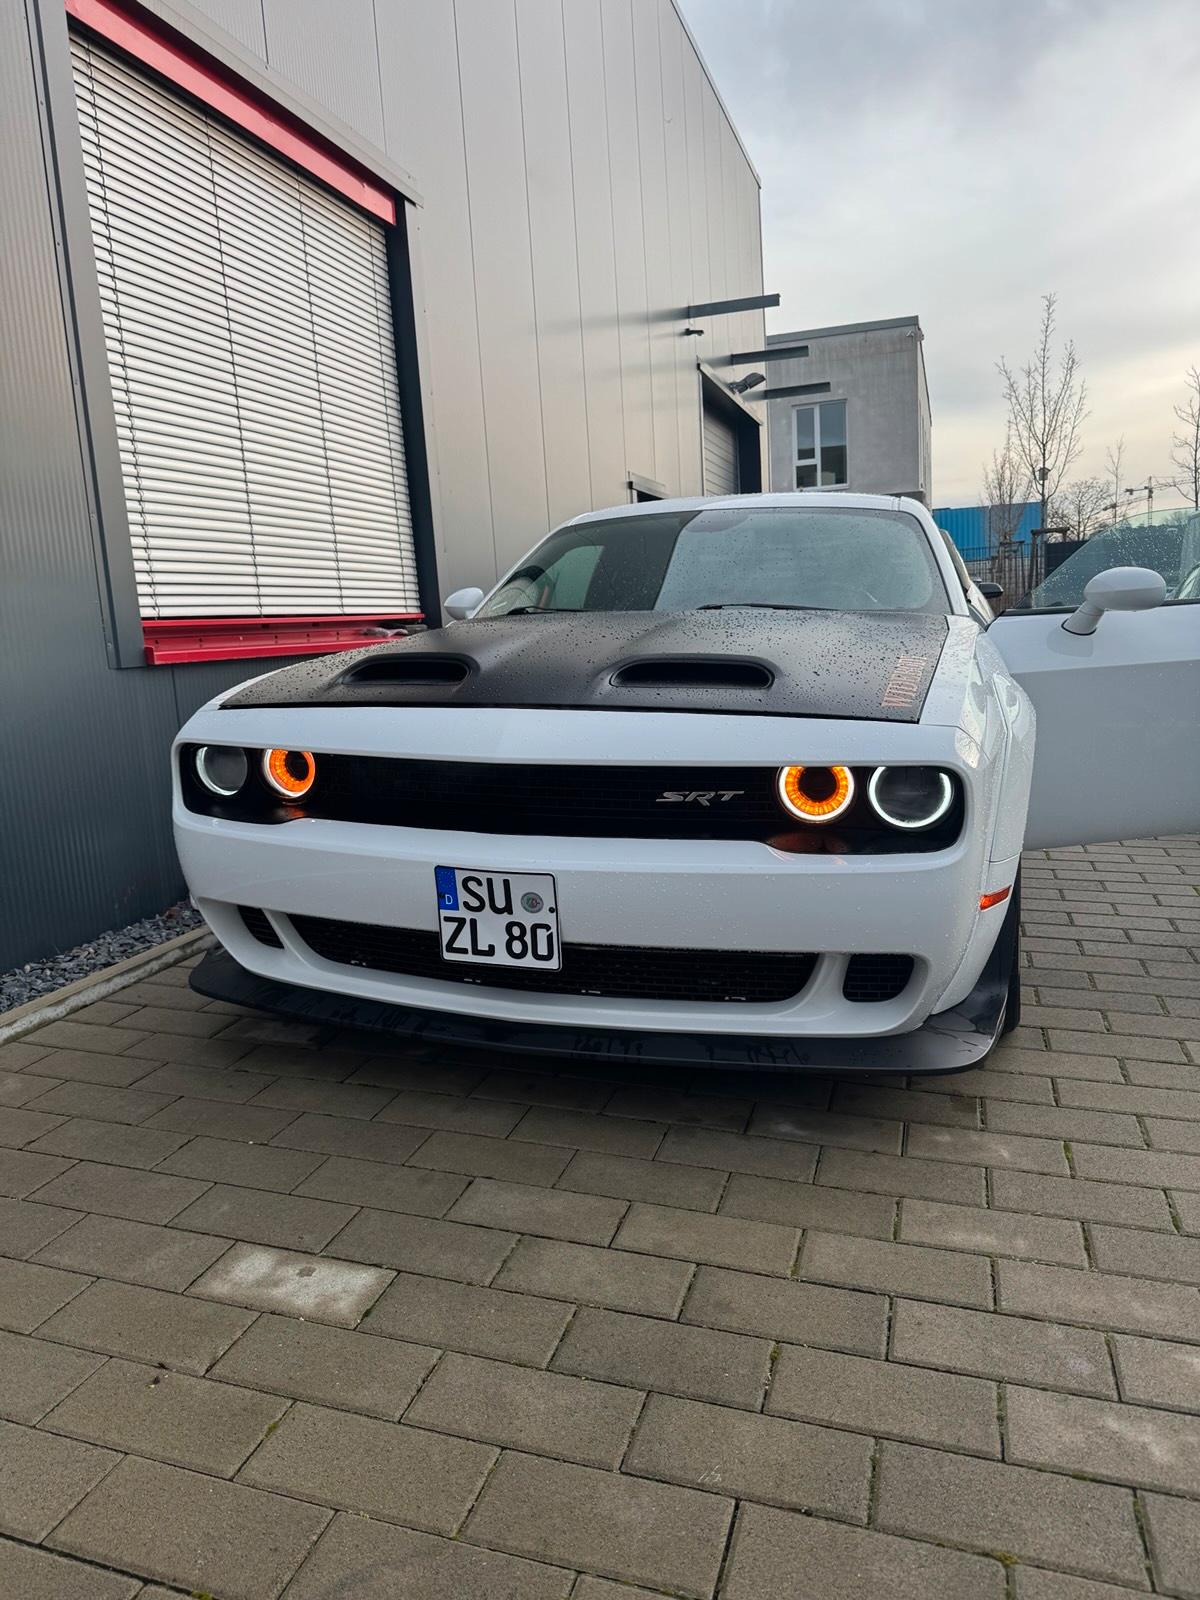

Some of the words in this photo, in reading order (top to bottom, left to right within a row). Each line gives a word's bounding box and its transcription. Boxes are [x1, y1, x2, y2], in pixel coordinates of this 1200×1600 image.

[655, 790, 745, 807] SRT
[445, 893, 454, 905] D
[461, 875, 514, 916] SU
[443, 916, 496, 957] ZL
[505, 921, 555, 962] 80
